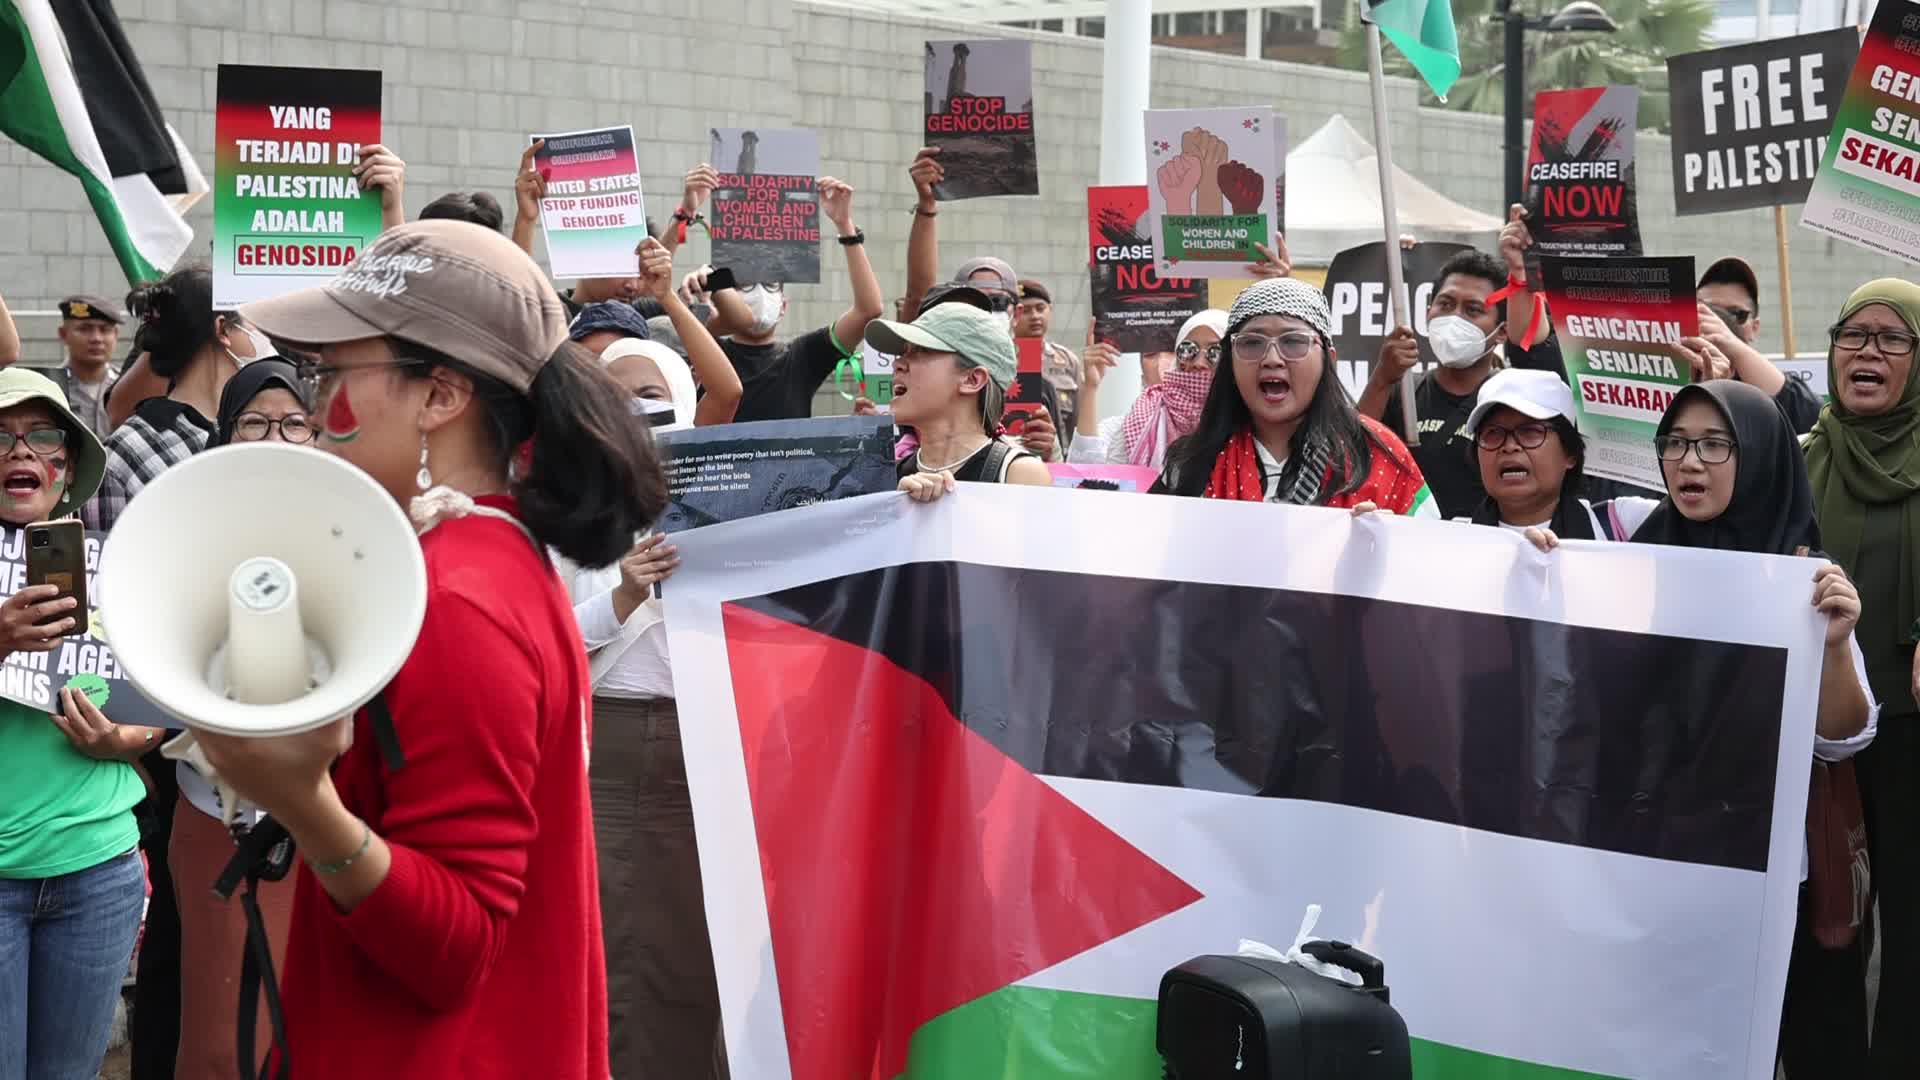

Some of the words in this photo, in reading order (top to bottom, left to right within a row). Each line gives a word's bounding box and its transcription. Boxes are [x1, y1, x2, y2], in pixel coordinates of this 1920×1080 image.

[1701, 53, 1828, 135] FREE
[951, 97, 1003, 114] STOP
[269, 105, 331, 130] YANG
[927, 114, 1030, 132] GENOCIDE
[236, 139, 330, 165] TERJADI
[337, 142, 361, 165] DI
[1530, 161, 1617, 180] CEASEFIRE
[236, 175, 361, 199] PALESTINA
[589, 174, 639, 192] STATES
[719, 175, 813, 190] SOLIDARITY
[544, 198, 576, 211] STOP
[580, 193, 638, 210] FUNDING
[747, 188, 780, 201] FOR
[1543, 184, 1624, 217] NOW
[715, 200, 777, 214] WOMEN
[782, 202, 817, 216] AND
[251, 209, 344, 233] ADALAH
[562, 213, 625, 228] GENOCIDE
[723, 213, 804, 228] CHILDREN
[1168, 217, 1236, 226] SOLIDARITY
[1239, 216, 1260, 226] FOR
[711, 226, 728, 239] IN
[732, 227, 820, 241] PALESTINE
[1182, 228, 1221, 239] WOMEN
[1224, 228, 1248, 239] AND
[1182, 239, 1235, 249] CHILDREN
[238, 244, 356, 267] GENOSIDA
[1153, 310, 1166, 318] ARE
[1565, 314, 1681, 345] GENCATAN
[1586, 349, 1679, 379] SENJATA
[733, 451, 754, 462] poetry
[756, 450, 769, 458] that
[770, 449, 784, 457] isn't
[785, 448, 815, 458] political,
[679, 466, 696, 474] listen
[717, 463, 734, 471] birds
[679, 476, 696, 484] order
[733, 471, 751, 480] birds
[702, 484, 719, 492] must
[720, 483, 729, 491] be
